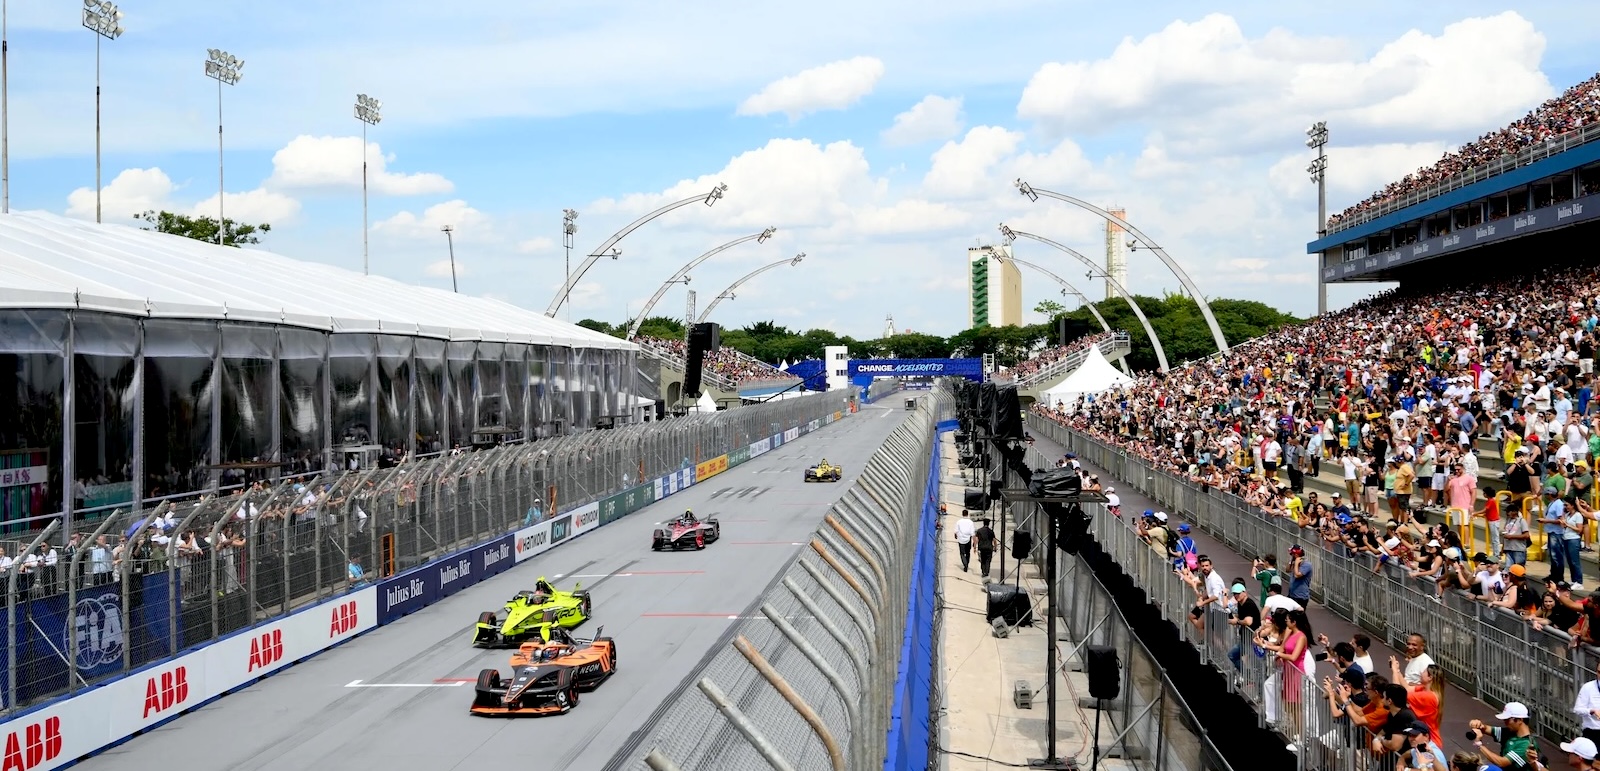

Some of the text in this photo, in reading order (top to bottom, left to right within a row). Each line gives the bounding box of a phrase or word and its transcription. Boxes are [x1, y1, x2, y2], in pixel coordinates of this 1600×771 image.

[1514, 214, 1536, 231] Julius Bär
[1557, 203, 1583, 221] Julius Bär
[1475, 225, 1496, 240] Julius Bär
[857, 364, 894, 372] CHANGE.
[608, 500, 616, 516] PIF
[484, 543, 510, 570] Julius Bär
[440, 559, 471, 589] Julius Bär
[386, 578, 424, 612] Julius Bär
[330, 600, 358, 638] ABB
[248, 629, 283, 673] ABB
[580, 664, 600, 674] NEOM
[143, 666, 189, 719] ABB
[1, 715, 62, 771] ABB
